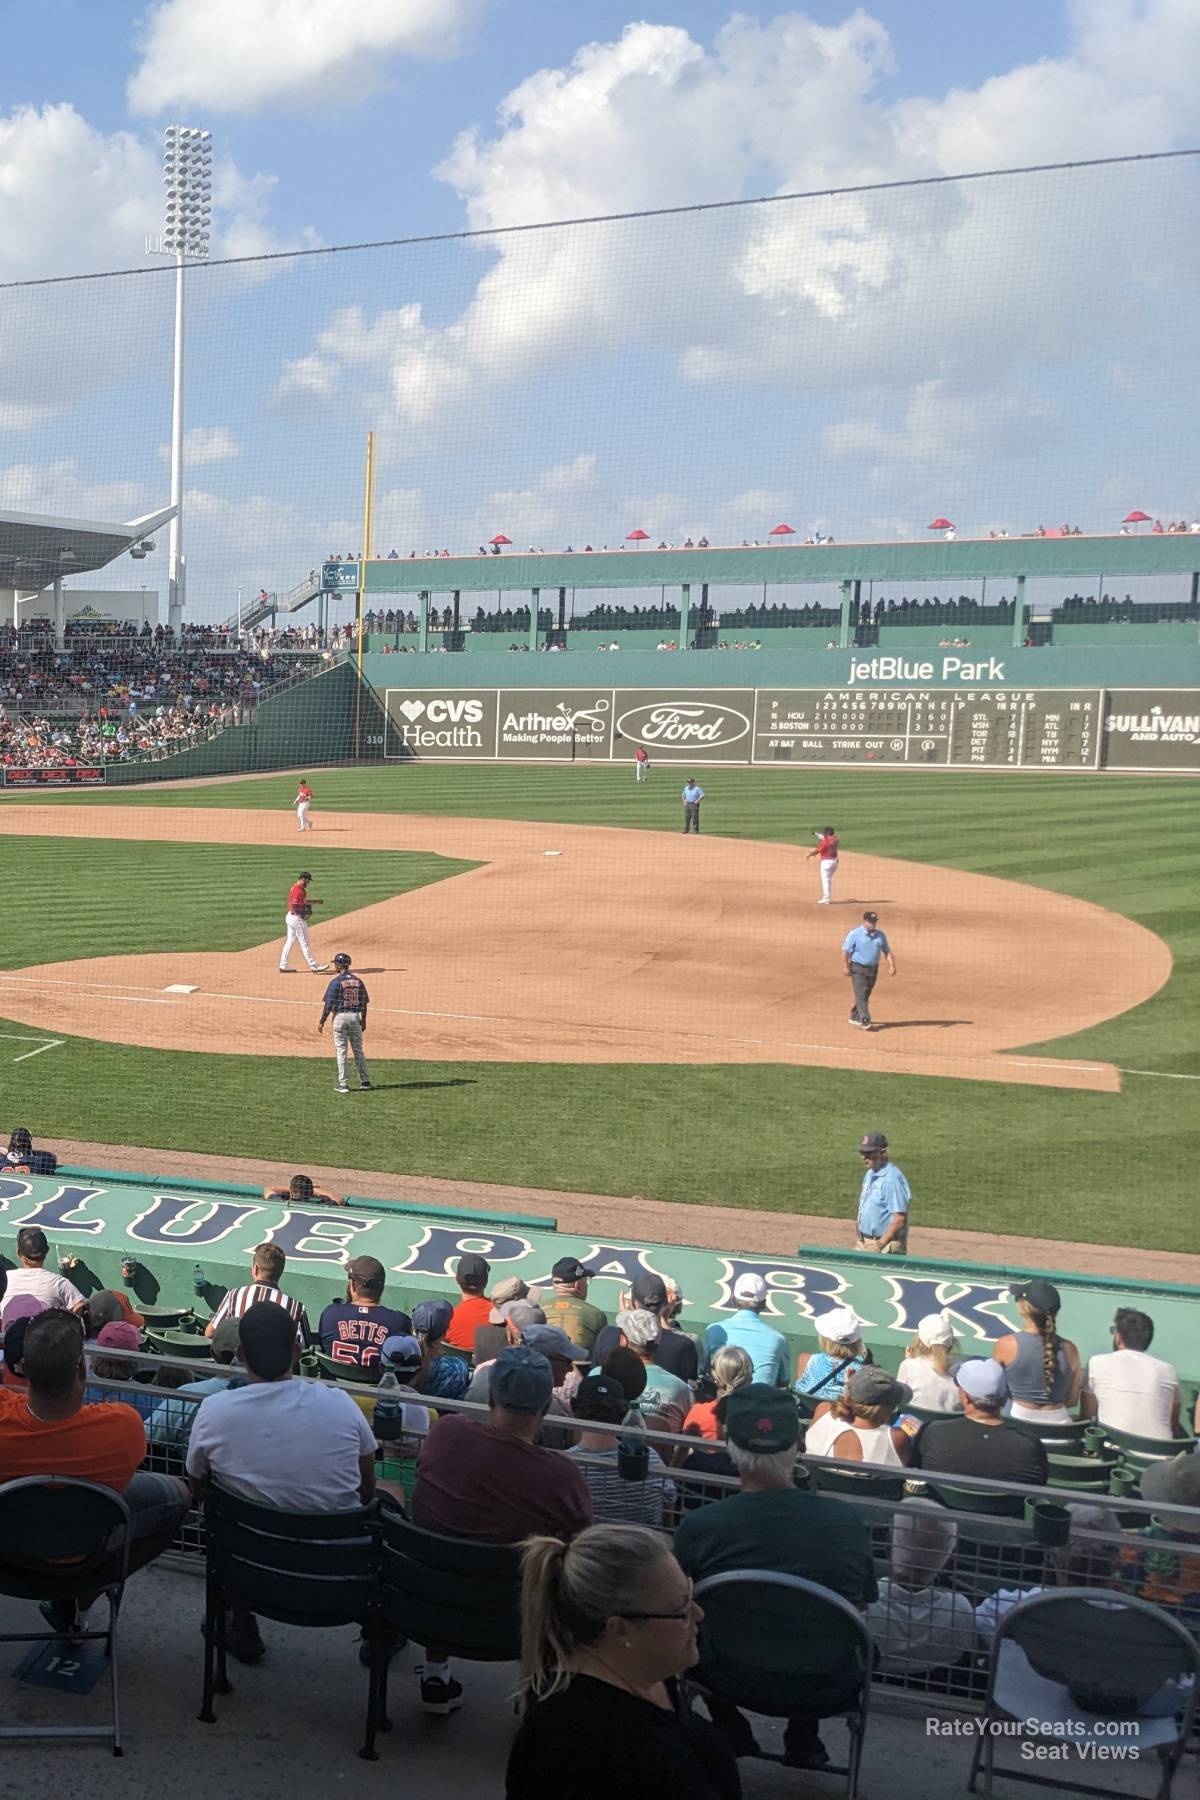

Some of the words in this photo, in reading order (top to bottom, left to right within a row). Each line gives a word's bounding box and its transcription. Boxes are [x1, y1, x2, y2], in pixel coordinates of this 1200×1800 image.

[848, 657, 934, 684] jetBlue
[942, 658, 1005, 680] Park
[427, 700, 482, 722] CVS
[503, 712, 576, 731] Arthrex
[641, 707, 724, 741] Ford
[1104, 715, 1200, 732] SULLIVAN
[366, 736, 384, 744] 310
[402, 726, 482, 747] Health
[503, 734, 538, 744] Making
[540, 734, 572, 744] People
[575, 735, 604, 743] Better
[392, 1225, 1022, 1343] PARK
[338, 1320, 388, 1344] BETTS
[46, 1657, 80, 1676] 12
